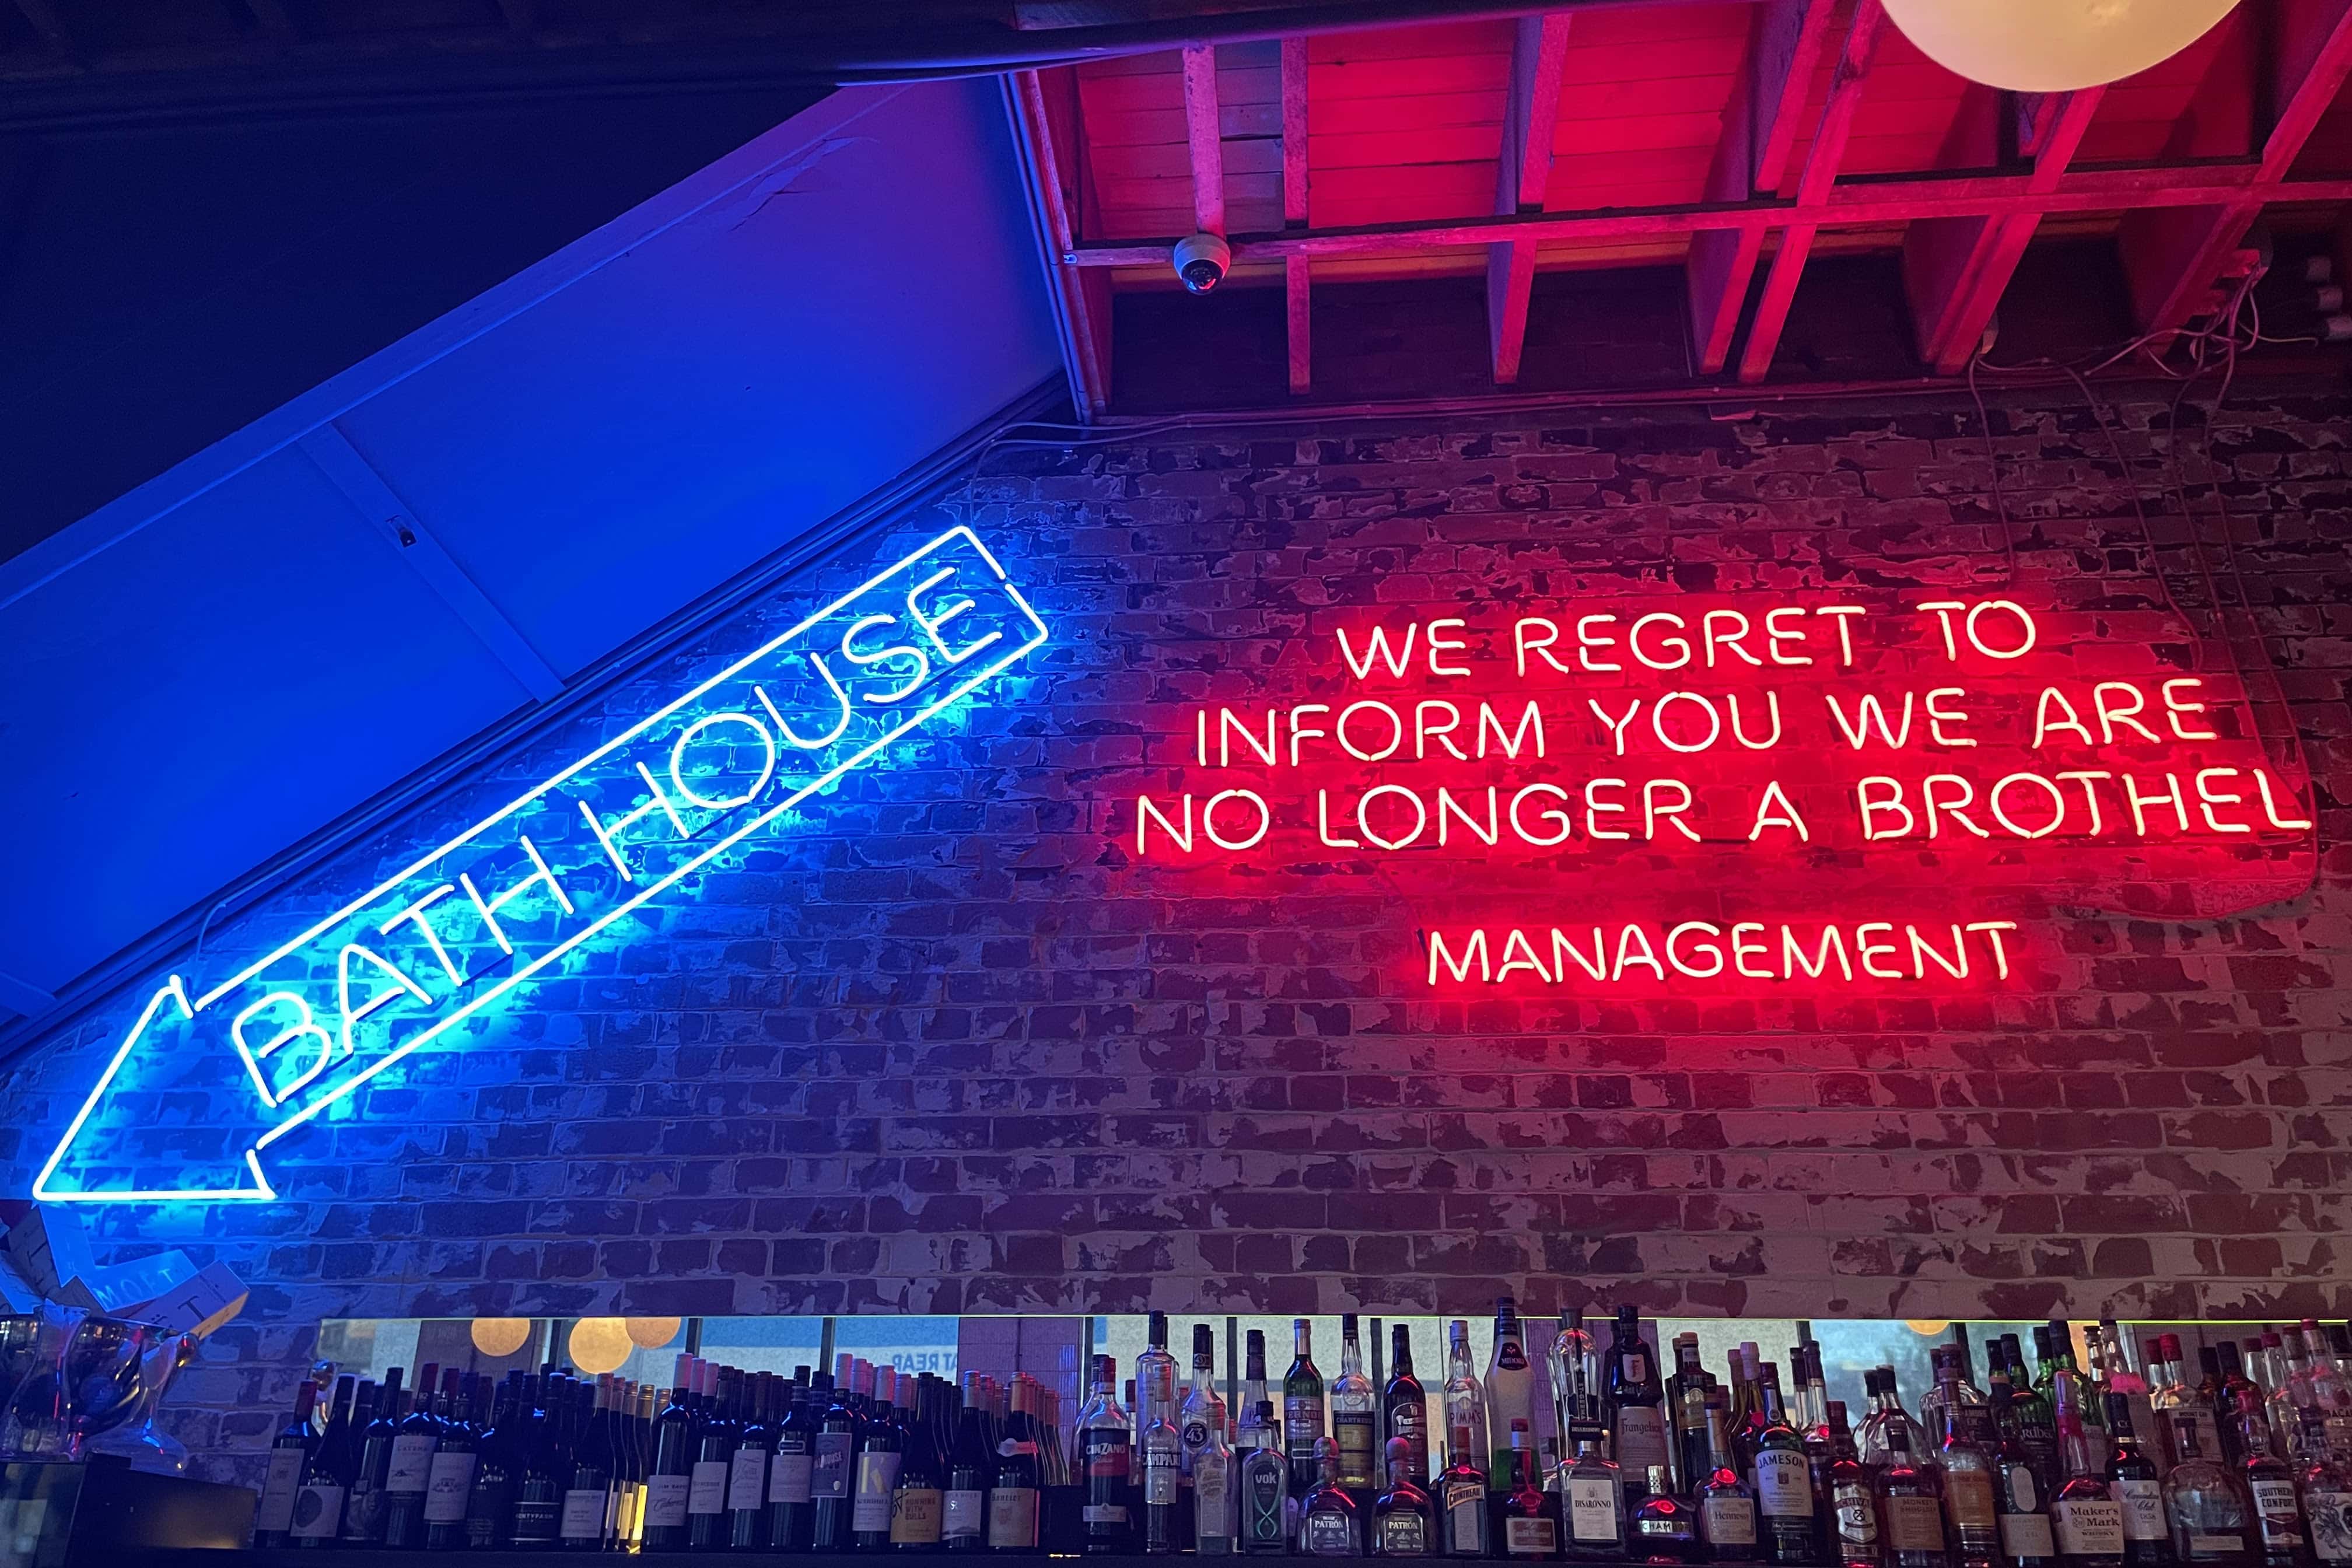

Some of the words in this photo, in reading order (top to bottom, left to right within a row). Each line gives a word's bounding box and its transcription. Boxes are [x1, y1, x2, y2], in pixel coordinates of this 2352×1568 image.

[1336, 618, 1471, 680] WE
[1517, 606, 1866, 677] REGRET
[1916, 600, 2036, 662] TO
[1198, 699, 1545, 767] INFORM
[1588, 691, 1782, 757] YOU
[1826, 687, 1978, 751] WE
[2032, 678, 2218, 749] ARE
[1136, 789, 1270, 855] NO
[1318, 778, 1702, 850] LONGER
[1748, 780, 1809, 842] A
[1856, 767, 2313, 841] BROTHEL
[229, 835, 575, 1108] BATH
[578, 566, 1003, 882] HOUSE
[1427, 921, 2018, 986] MANAGEMENT
[1450, 1409, 1482, 1424] PIMM'S
[1185, 1427, 1204, 1442] 43
[1085, 1442, 1126, 1455] CINZANO
[1142, 1452, 1182, 1466] CAMPARI
[1759, 1455, 1804, 1469] JAMESON
[1449, 1487, 1480, 1506] COINTREAU
[1574, 1499, 1611, 1508] DISARONNO
[2070, 1507, 2119, 1516] Maker's
[2086, 1517, 2120, 1527] Mark
